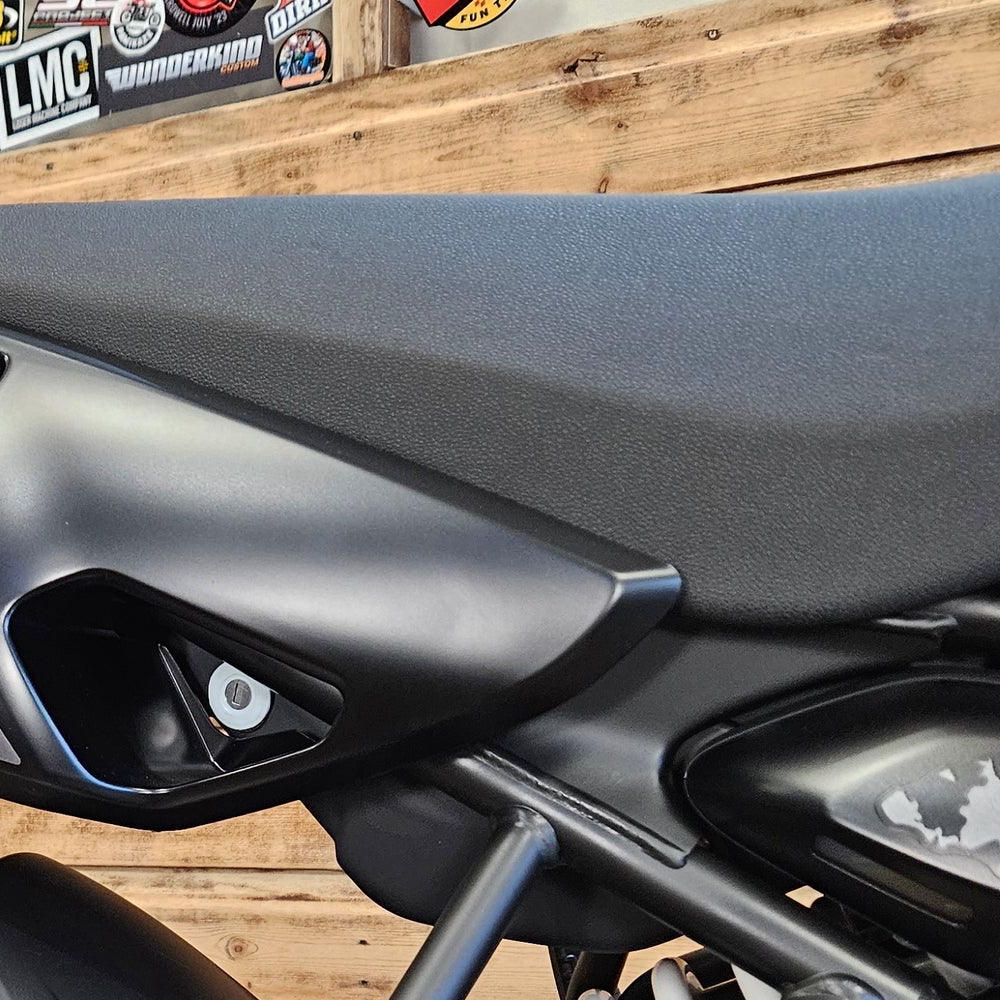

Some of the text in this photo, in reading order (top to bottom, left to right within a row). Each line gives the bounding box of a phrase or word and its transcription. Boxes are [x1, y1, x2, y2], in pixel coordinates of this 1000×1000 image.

[460, 8, 489, 23] FUN
[5, 40, 91, 119] LMC
[105, 35, 263, 93] WUNDERKIND
[220, 58, 260, 74] CUSTOM
